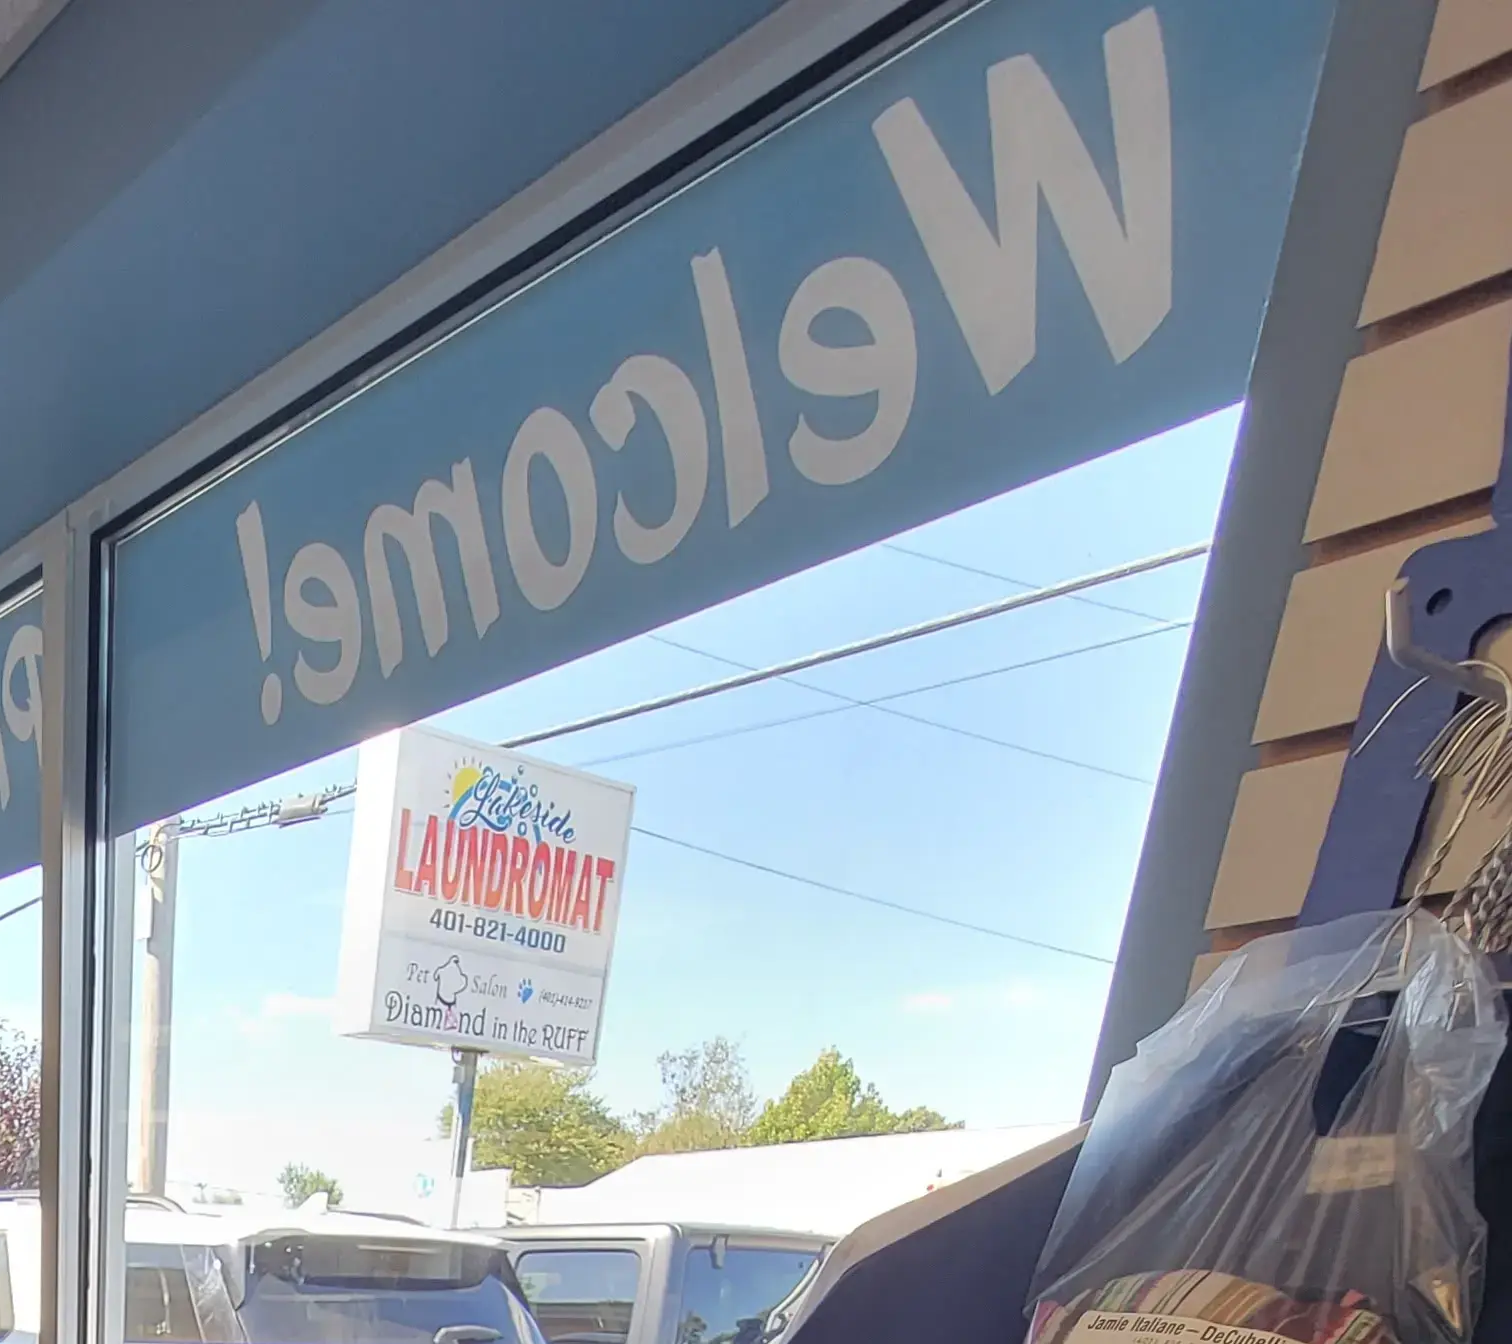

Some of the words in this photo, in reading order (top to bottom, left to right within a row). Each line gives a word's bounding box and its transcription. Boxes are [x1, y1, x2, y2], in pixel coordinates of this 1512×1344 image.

[459, 769, 577, 844] Lakeside
[394, 808, 616, 935] LAUNDROMAT
[429, 908, 567, 954] 401-821-4000
[406, 962, 430, 985] Pet
[470, 973, 508, 999] Salon
[491, 1015, 508, 1040] in
[512, 1018, 538, 1046] the
[541, 1022, 591, 1053] RUFF
[1087, 1314, 1129, 1332] Jamie
